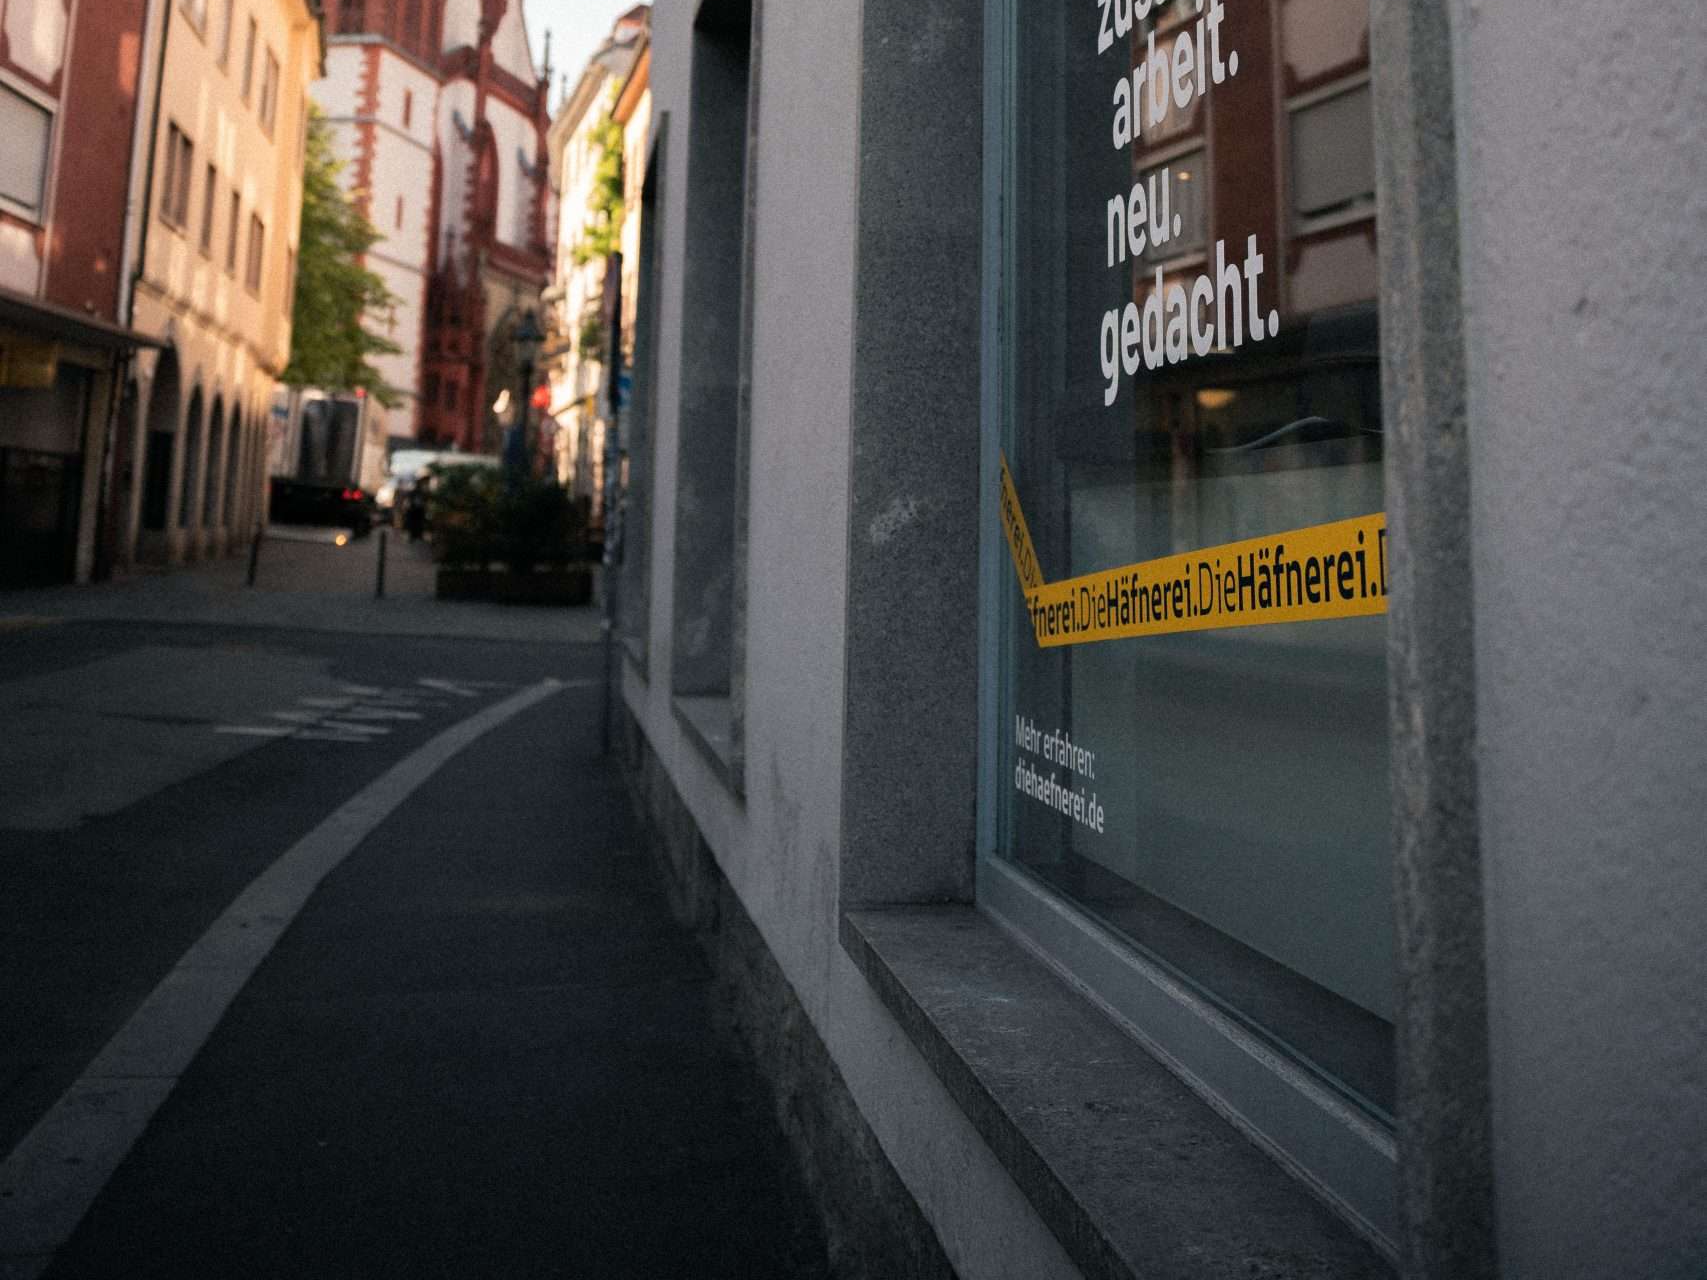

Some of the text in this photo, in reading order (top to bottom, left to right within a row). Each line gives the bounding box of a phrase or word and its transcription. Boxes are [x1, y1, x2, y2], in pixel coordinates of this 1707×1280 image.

[1107, 167, 1182, 268] neu.
[1101, 233, 1280, 407] gedacht.
[1015, 714, 1095, 780] Mehr erfahren:
[1015, 756, 1105, 834] diehaefnerei.de
